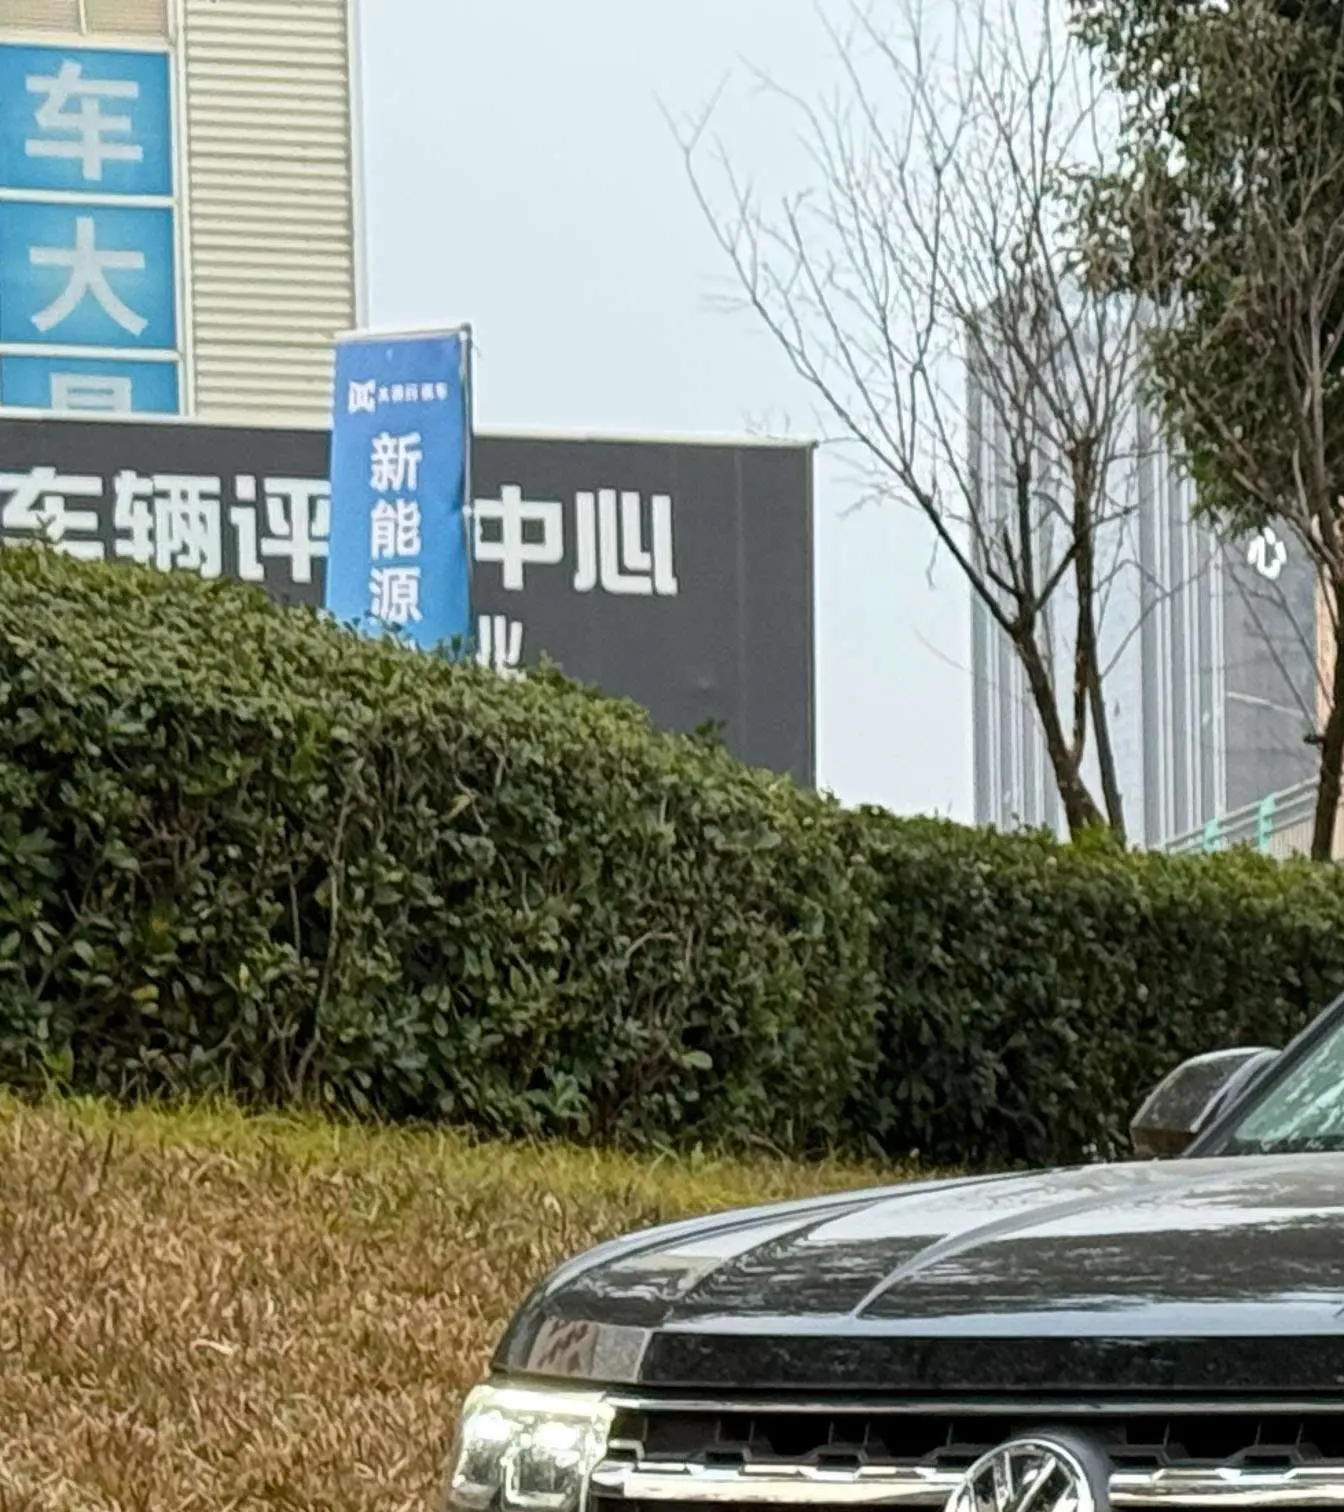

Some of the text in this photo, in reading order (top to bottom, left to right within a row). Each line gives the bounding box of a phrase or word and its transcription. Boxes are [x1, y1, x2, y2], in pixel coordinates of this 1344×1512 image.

[0, 466, 679, 597] 车辆评中心
